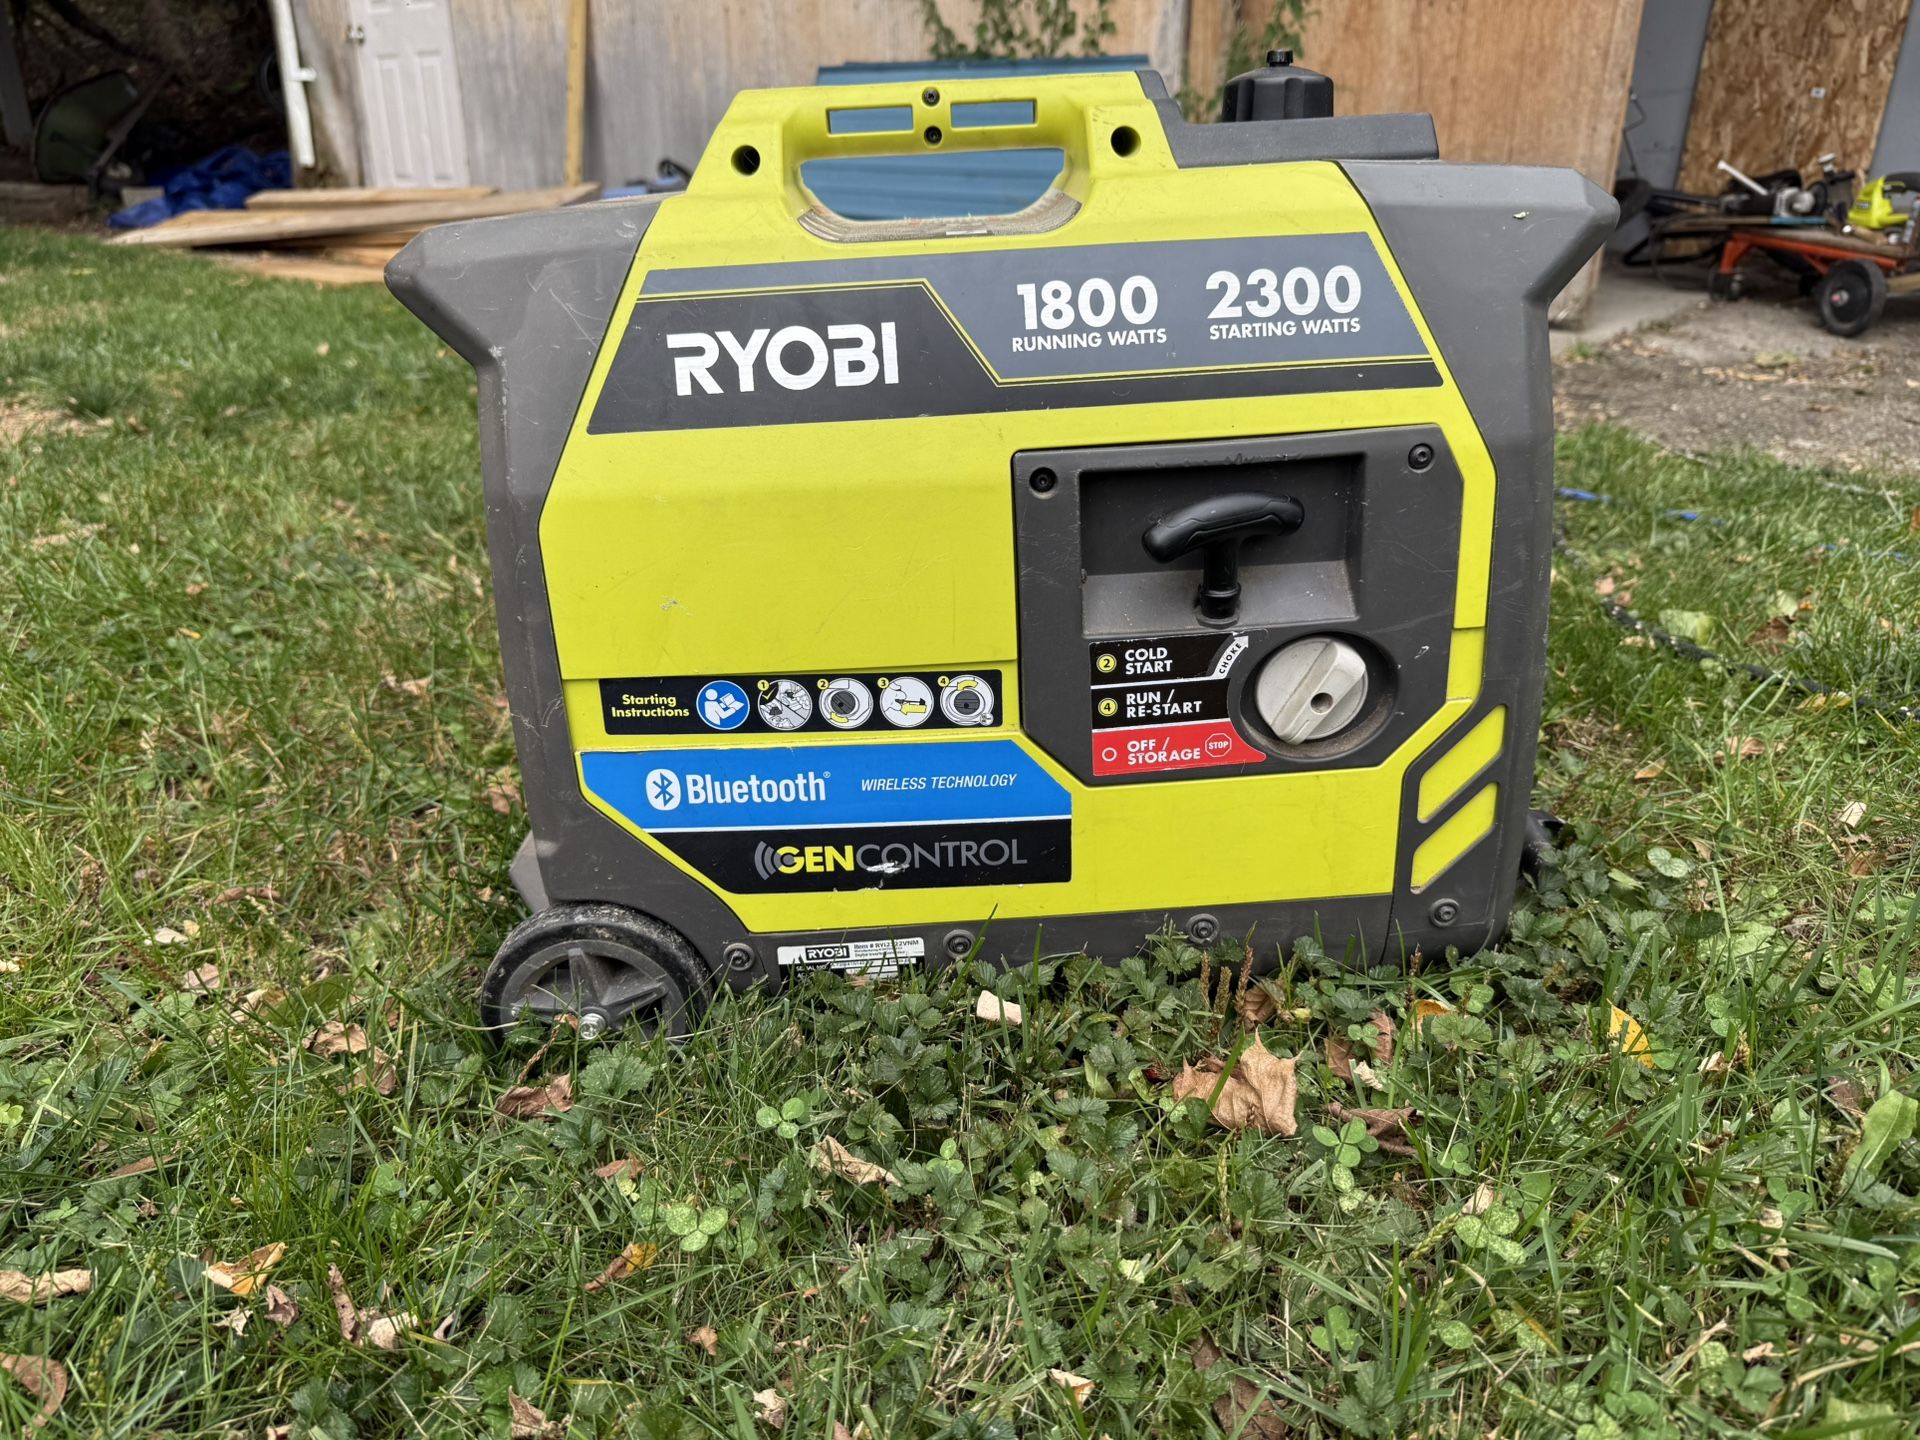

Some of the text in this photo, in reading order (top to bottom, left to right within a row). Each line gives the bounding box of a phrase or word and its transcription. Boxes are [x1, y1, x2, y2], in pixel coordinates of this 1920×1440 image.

[1205, 265, 1362, 318] 2300
[1016, 275, 1158, 330] 1800
[1209, 317, 1361, 340] STARTING WATTS
[1012, 328, 1168, 353] RUNNING WATTS
[666, 322, 899, 396] RYOBI
[1125, 647, 1168, 662] COLD
[1219, 641, 1243, 674] CHOKE
[1102, 658, 1112, 669] 2
[1125, 660, 1173, 675] START
[622, 694, 677, 707] Starting
[1126, 689, 1175, 705] RUN /
[611, 705, 690, 718] Instructions
[1103, 702, 1112, 712] 4
[1126, 702, 1202, 717] RE-START
[1127, 736, 1170, 752] OFF /
[1208, 740, 1229, 750] STOP
[1127, 748, 1201, 765] STORAGE
[861, 773, 1017, 791] WIRELESS TECHNOLOGY
[806, 947, 848, 959] RYOBI
